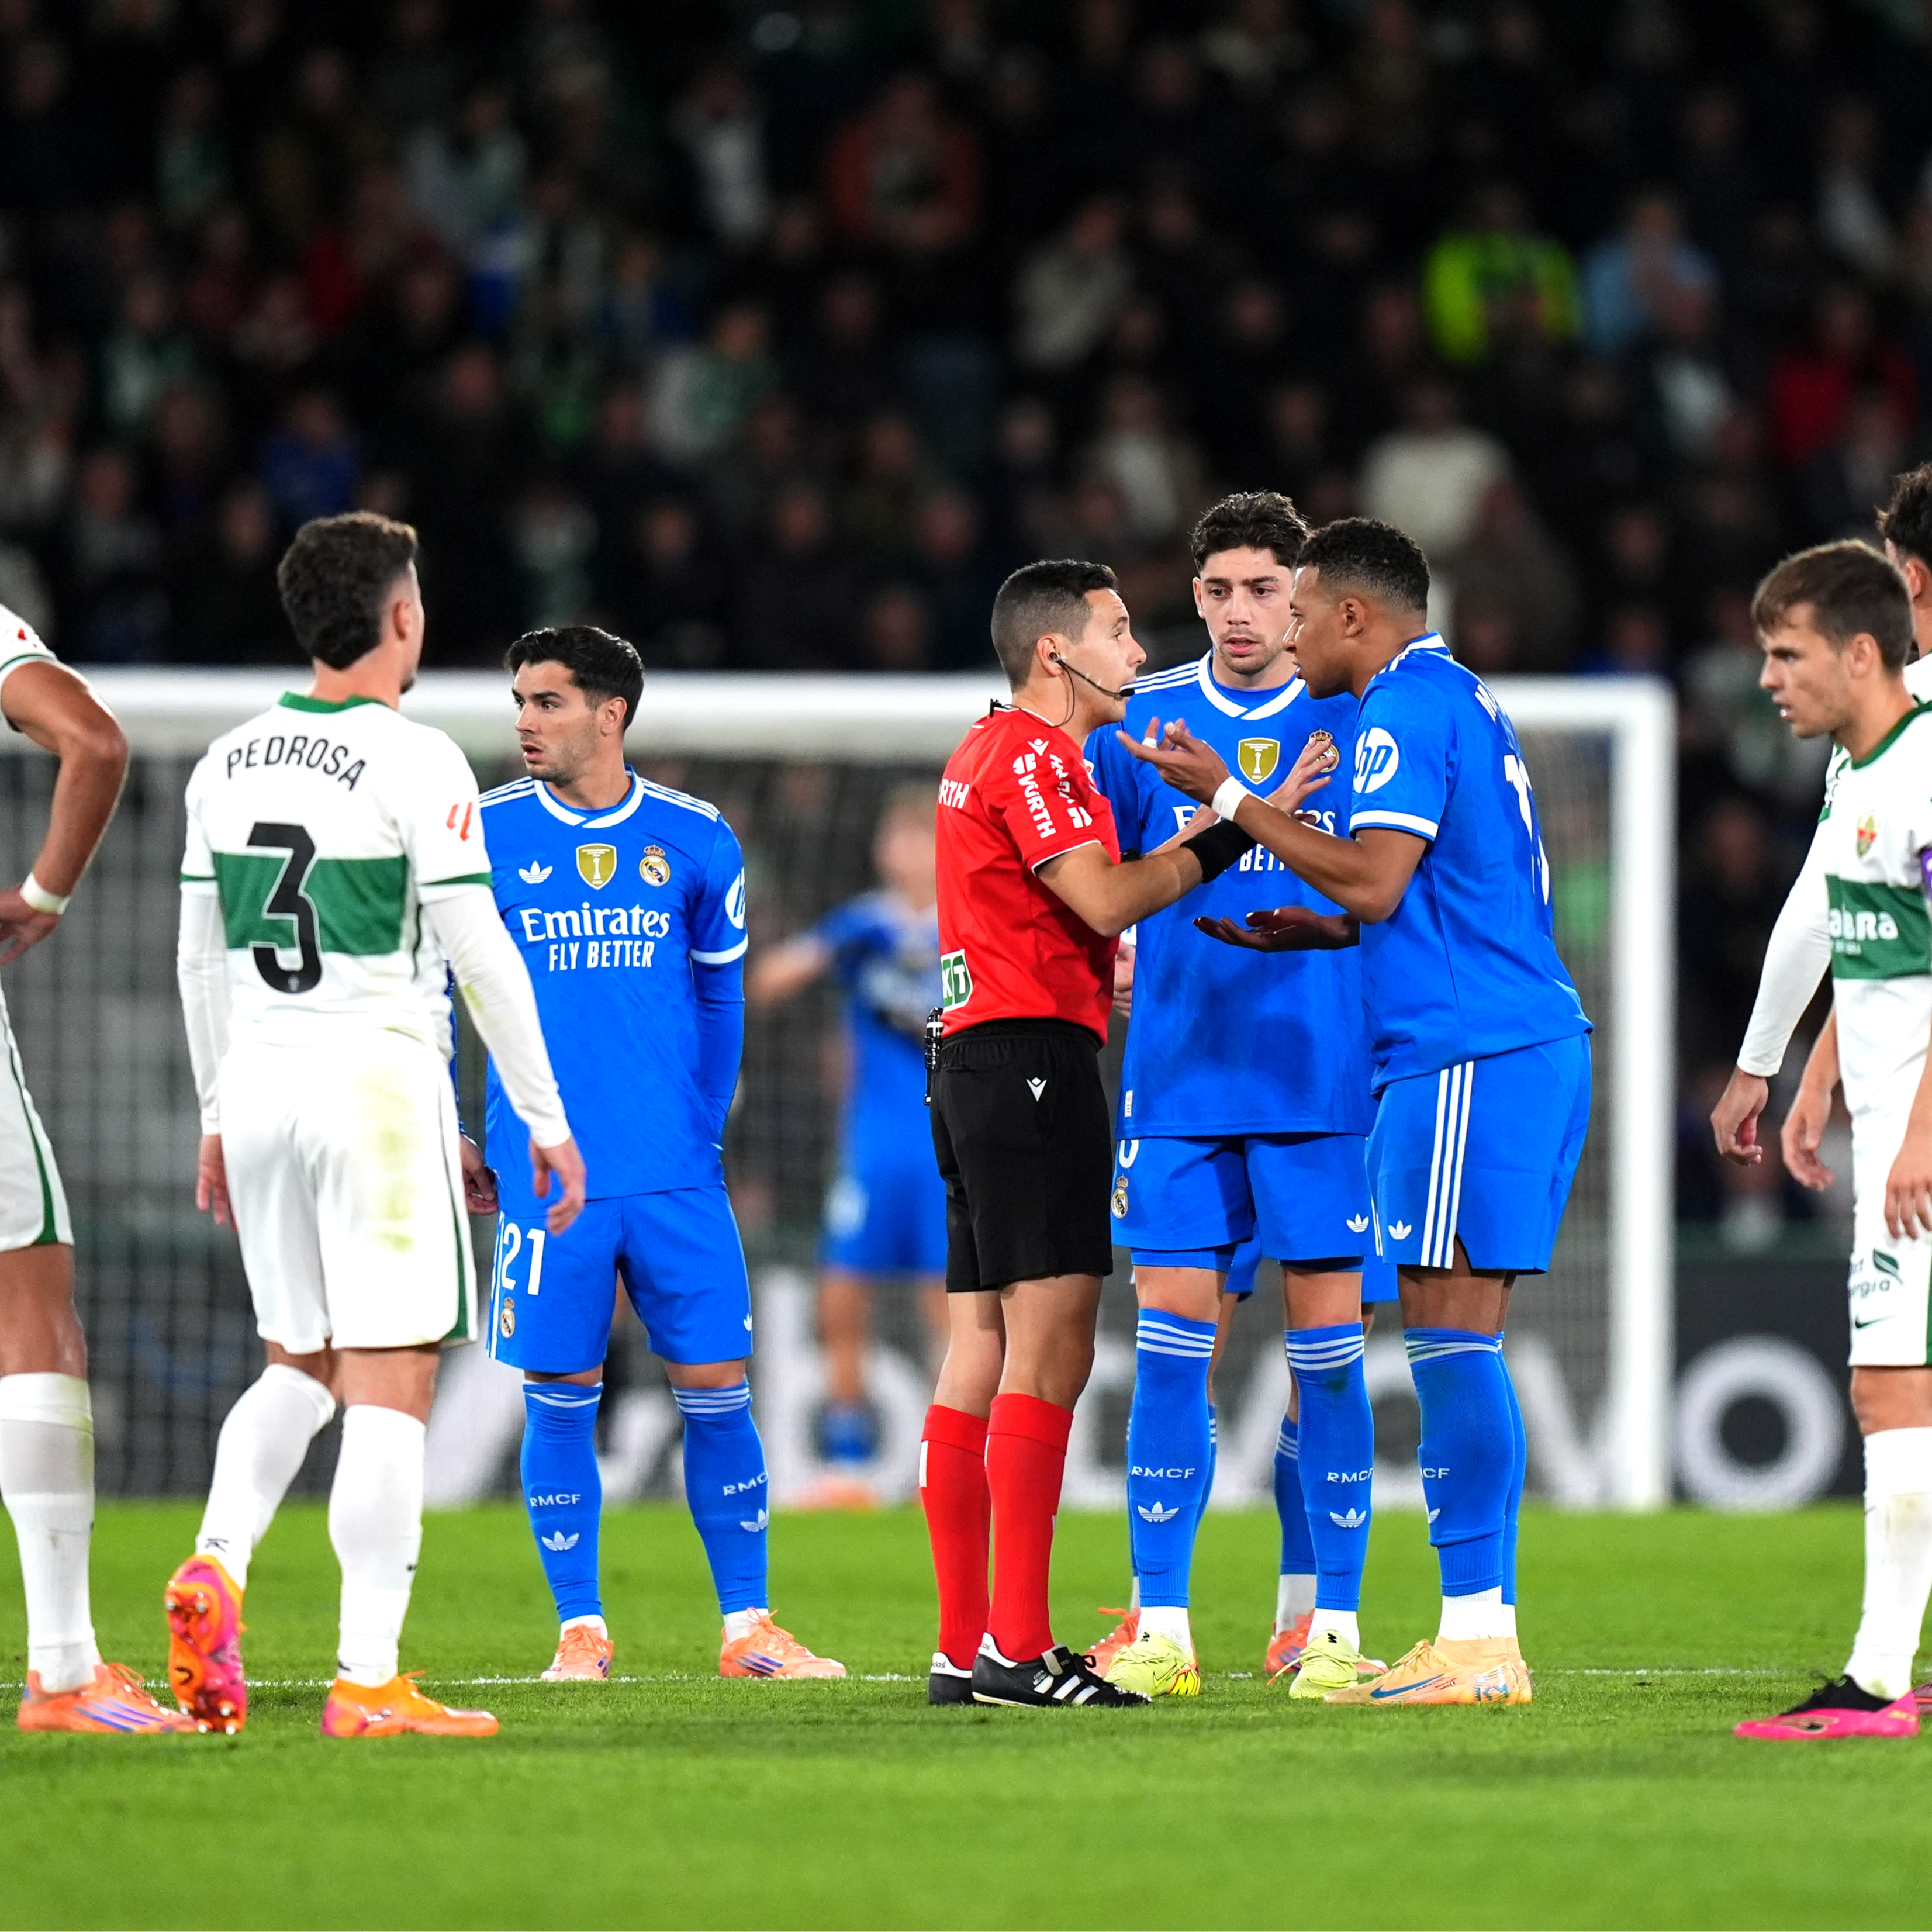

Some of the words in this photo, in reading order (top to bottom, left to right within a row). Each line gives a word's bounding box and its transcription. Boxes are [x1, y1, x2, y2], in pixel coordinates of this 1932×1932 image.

[227, 736, 367, 791] PEDROSA
[938, 779, 970, 809] RTH
[246, 821, 323, 994] 3
[520, 902, 671, 942] Emirates
[549, 942, 580, 972] FLY
[586, 940, 655, 969] BETTER
[501, 1222, 546, 1296] 21
[723, 1472, 768, 1496] RMC
[1131, 1466, 1196, 1479] RMCF
[1419, 1468, 1450, 1480] CF
[530, 1493, 582, 1508] RMCF
